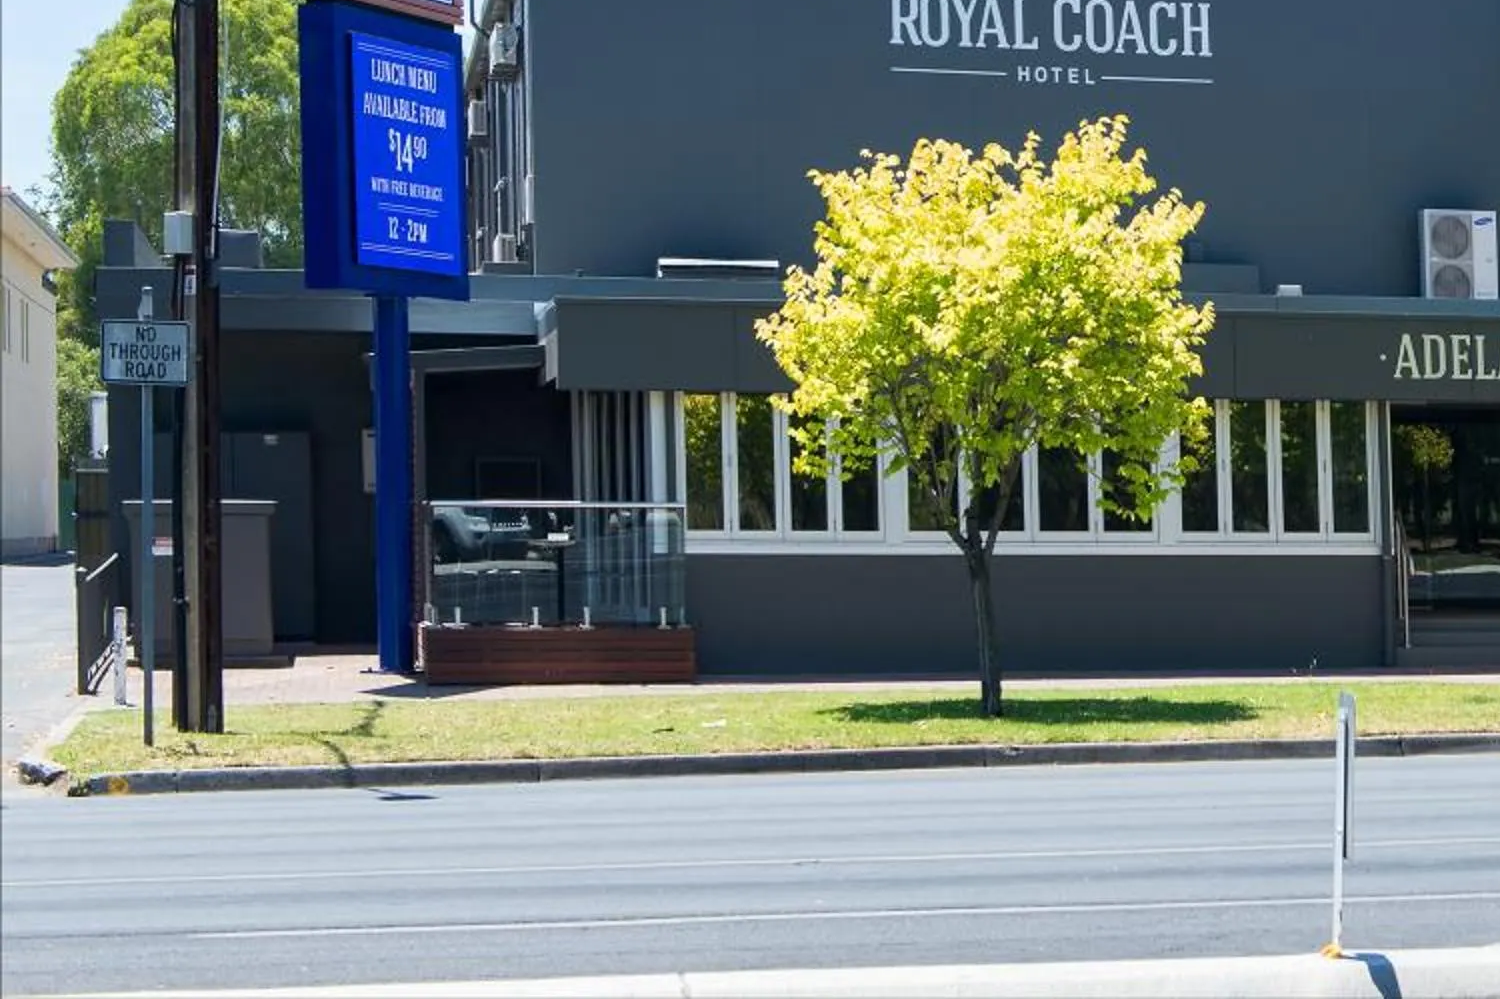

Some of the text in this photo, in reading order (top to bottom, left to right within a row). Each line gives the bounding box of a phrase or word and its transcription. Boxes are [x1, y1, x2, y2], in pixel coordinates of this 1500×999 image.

[371, 58, 437, 94] LUNCH MENU
[1016, 65, 1096, 85] HOTEL
[363, 91, 447, 130] AVAILABLE FROM
[371, 176, 443, 202] WITH FREE BEVERAGE
[388, 216, 399, 240] 12
[407, 218, 427, 243] 2PM
[135, 326, 157, 343] NO
[109, 342, 181, 362] THROUGH
[125, 361, 167, 379] ROAD
